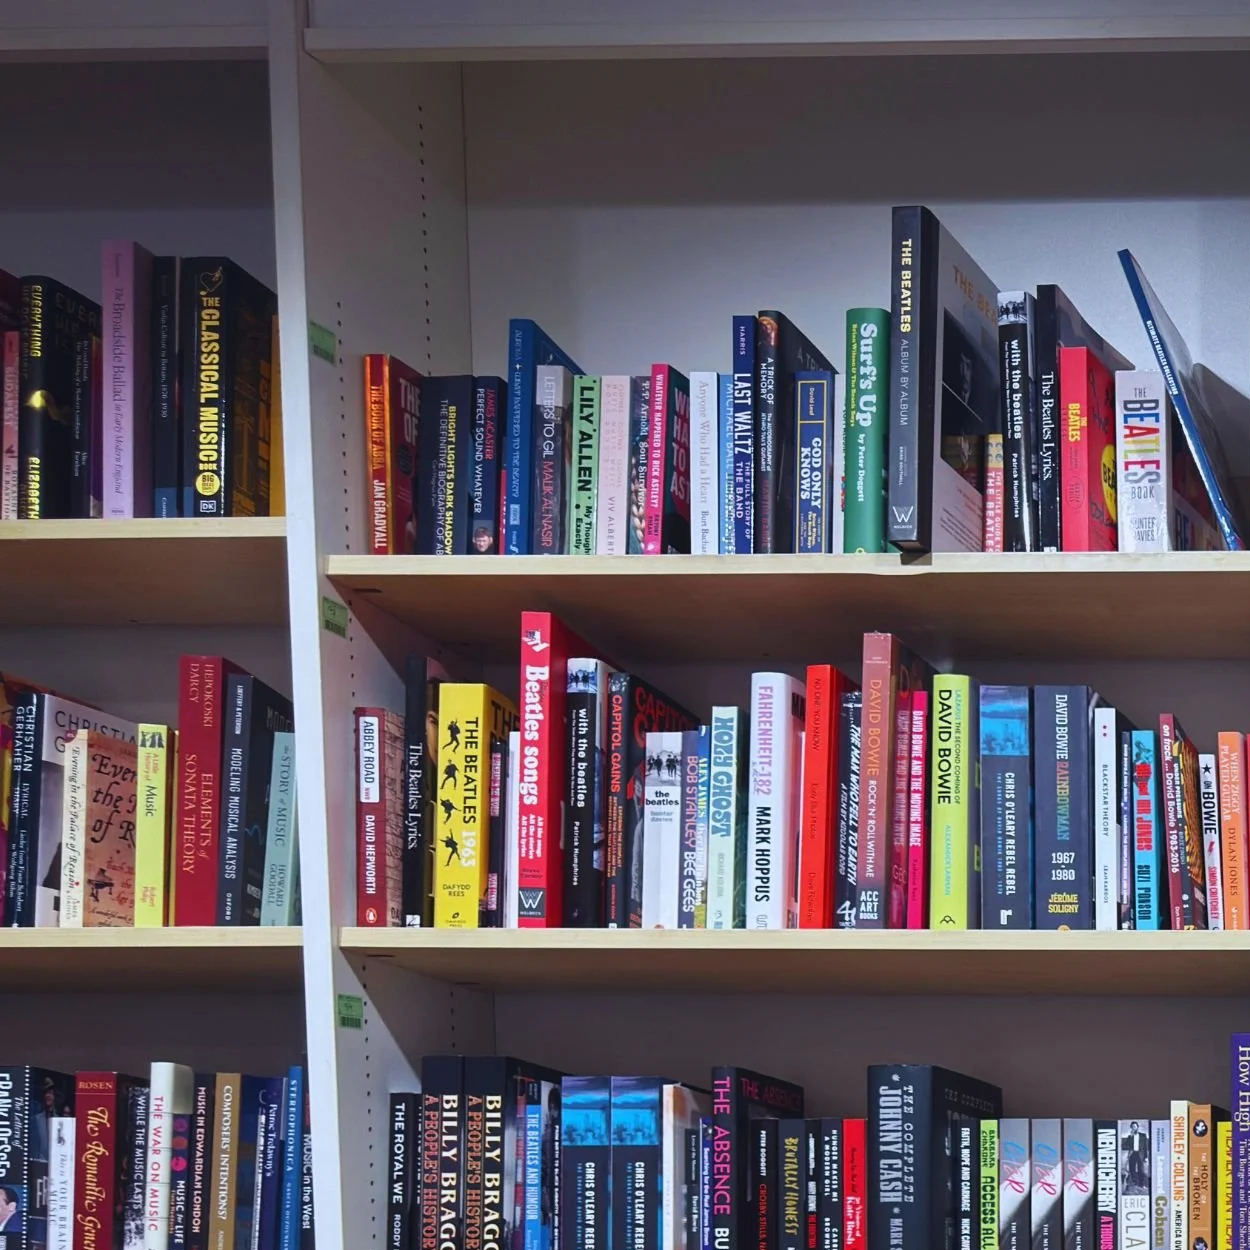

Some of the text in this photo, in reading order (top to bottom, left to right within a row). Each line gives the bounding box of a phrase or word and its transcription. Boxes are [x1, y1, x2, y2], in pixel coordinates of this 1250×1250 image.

[199, 309, 220, 461] CLASSICAL MUSIC
[734, 373, 752, 454] LAST WALTZ
[856, 323, 877, 426] Surf's Up
[474, 389, 484, 513] PERFECT SOUND WHATEVER
[578, 387, 594, 491] LILY ALLEN
[801, 448, 811, 499] KNOWS
[811, 438, 821, 507] GOD ONLY
[520, 666, 549, 804] Beatles songs
[938, 690, 951, 804] DAVID BOWIE
[182, 754, 196, 873] SONATA THEORY
[200, 774, 213, 846] ELEMENTS
[366, 815, 376, 894] DAVID HEPWORTH
[755, 807, 770, 901] MARK HOPPUS
[87, 1107, 109, 1135] The
[484, 1095, 502, 1162] BILLY
[714, 1076, 730, 1114] THE
[82, 1142, 105, 1212] Romantic
[393, 1104, 405, 1203] THE ROYAL WE
[714, 1126, 730, 1215] ABSENCE
[879, 1086, 901, 1202] JOHNNY CASH
